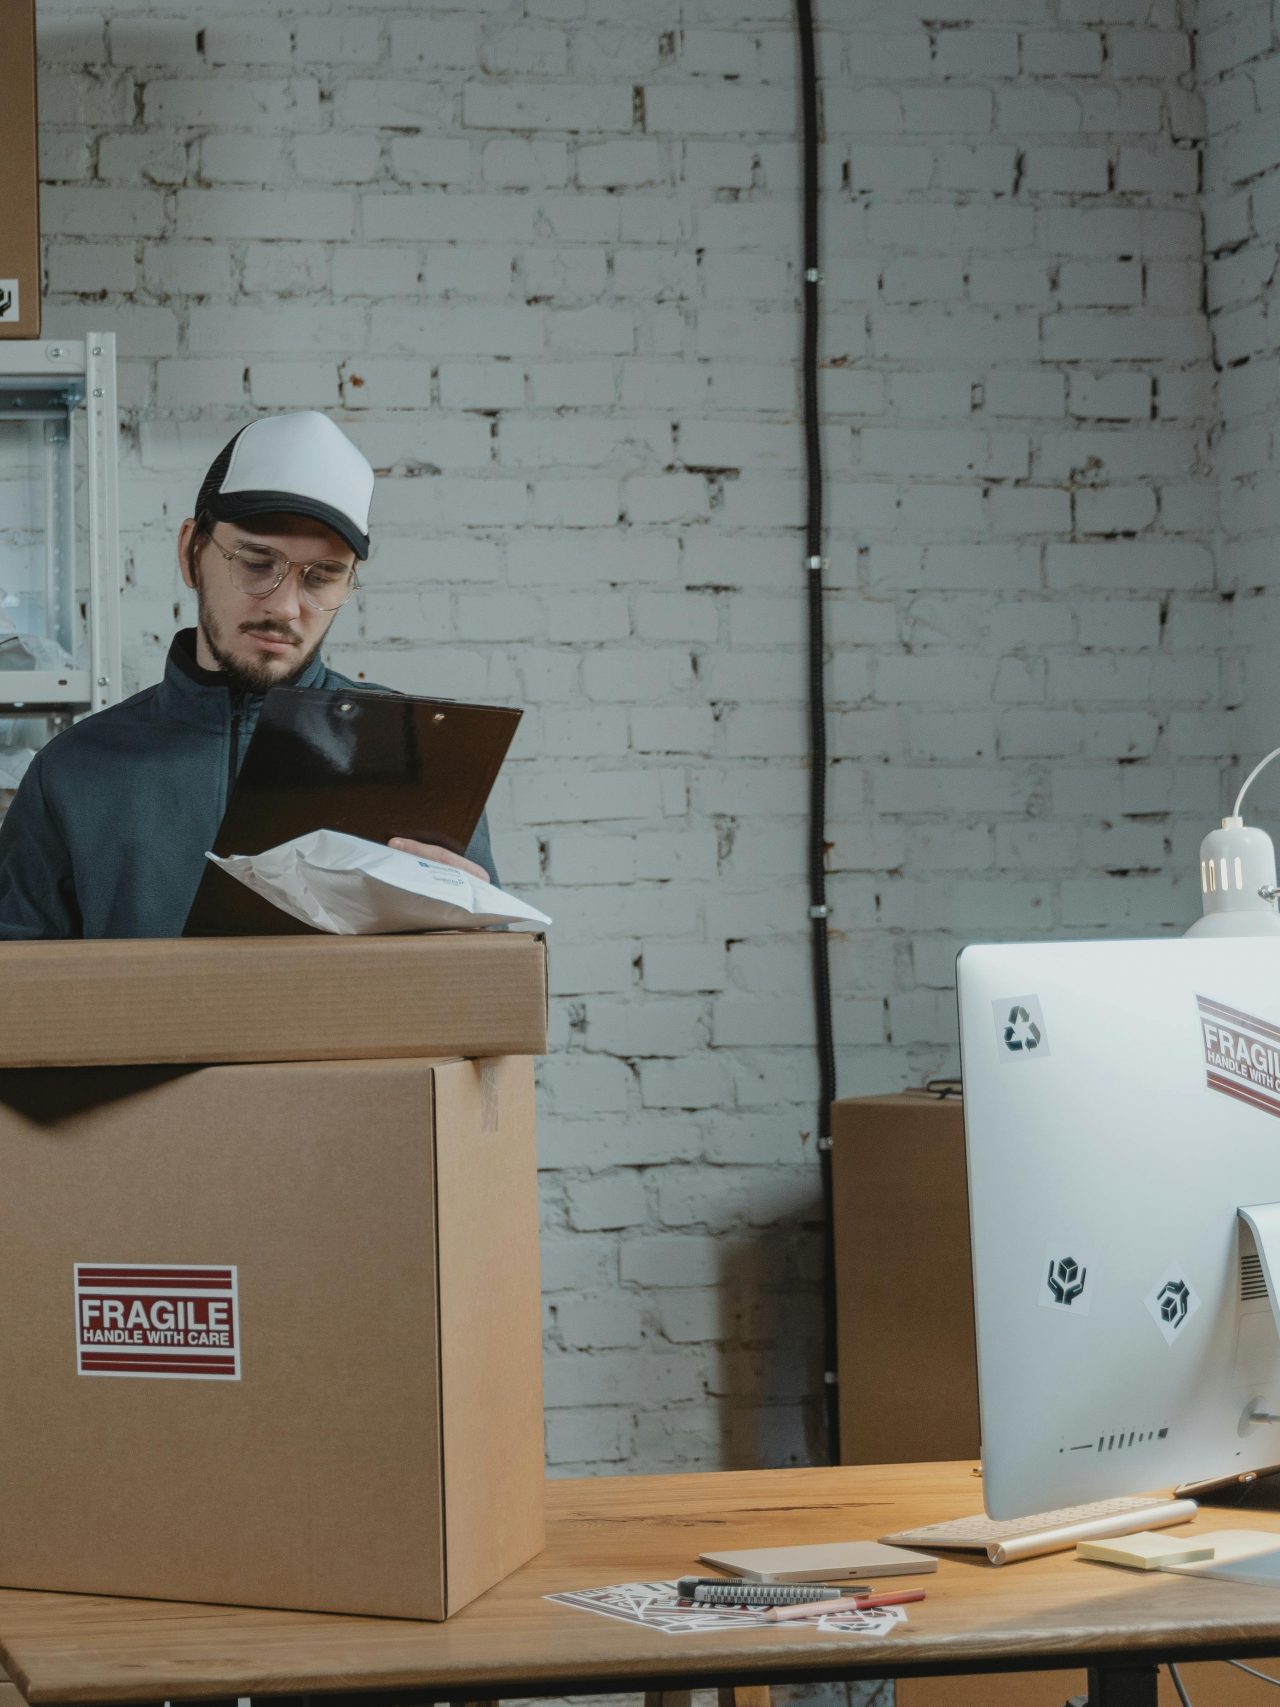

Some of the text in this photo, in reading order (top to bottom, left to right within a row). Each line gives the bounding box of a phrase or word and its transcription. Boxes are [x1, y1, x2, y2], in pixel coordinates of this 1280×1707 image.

[1204, 1023, 1280, 1079] FRAGIL
[1207, 1050, 1248, 1077] HANDLE
[1248, 1067, 1274, 1089] WITH
[82, 1299, 230, 1331] FRAGILE
[83, 1329, 230, 1346] HANDLE WITH CARE
